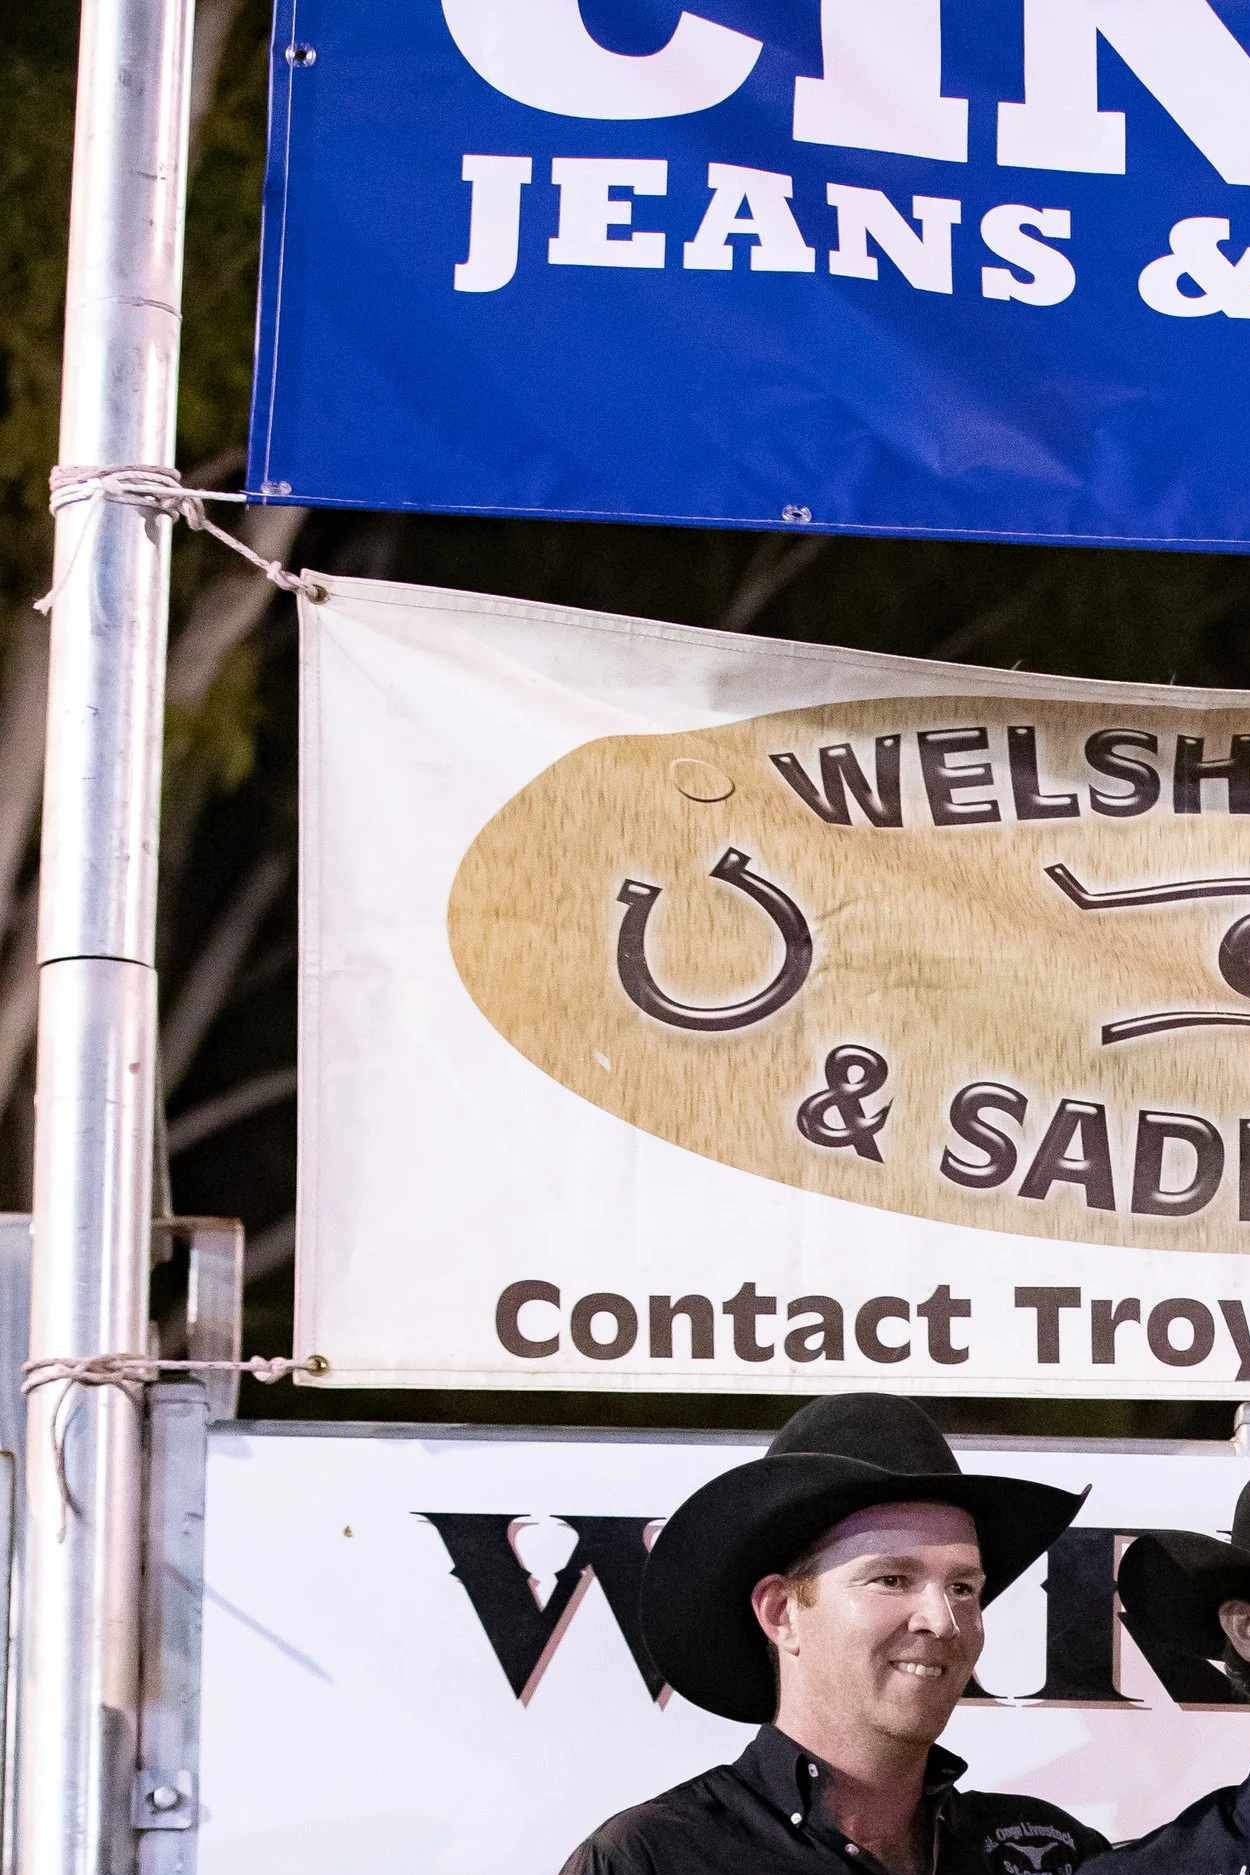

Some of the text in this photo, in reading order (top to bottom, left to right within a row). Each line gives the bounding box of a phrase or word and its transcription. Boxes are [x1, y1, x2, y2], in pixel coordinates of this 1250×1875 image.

[453, 153, 1077, 308] JEANS
[796, 1043, 895, 1163] &
[494, 1278, 973, 1365] Contact
